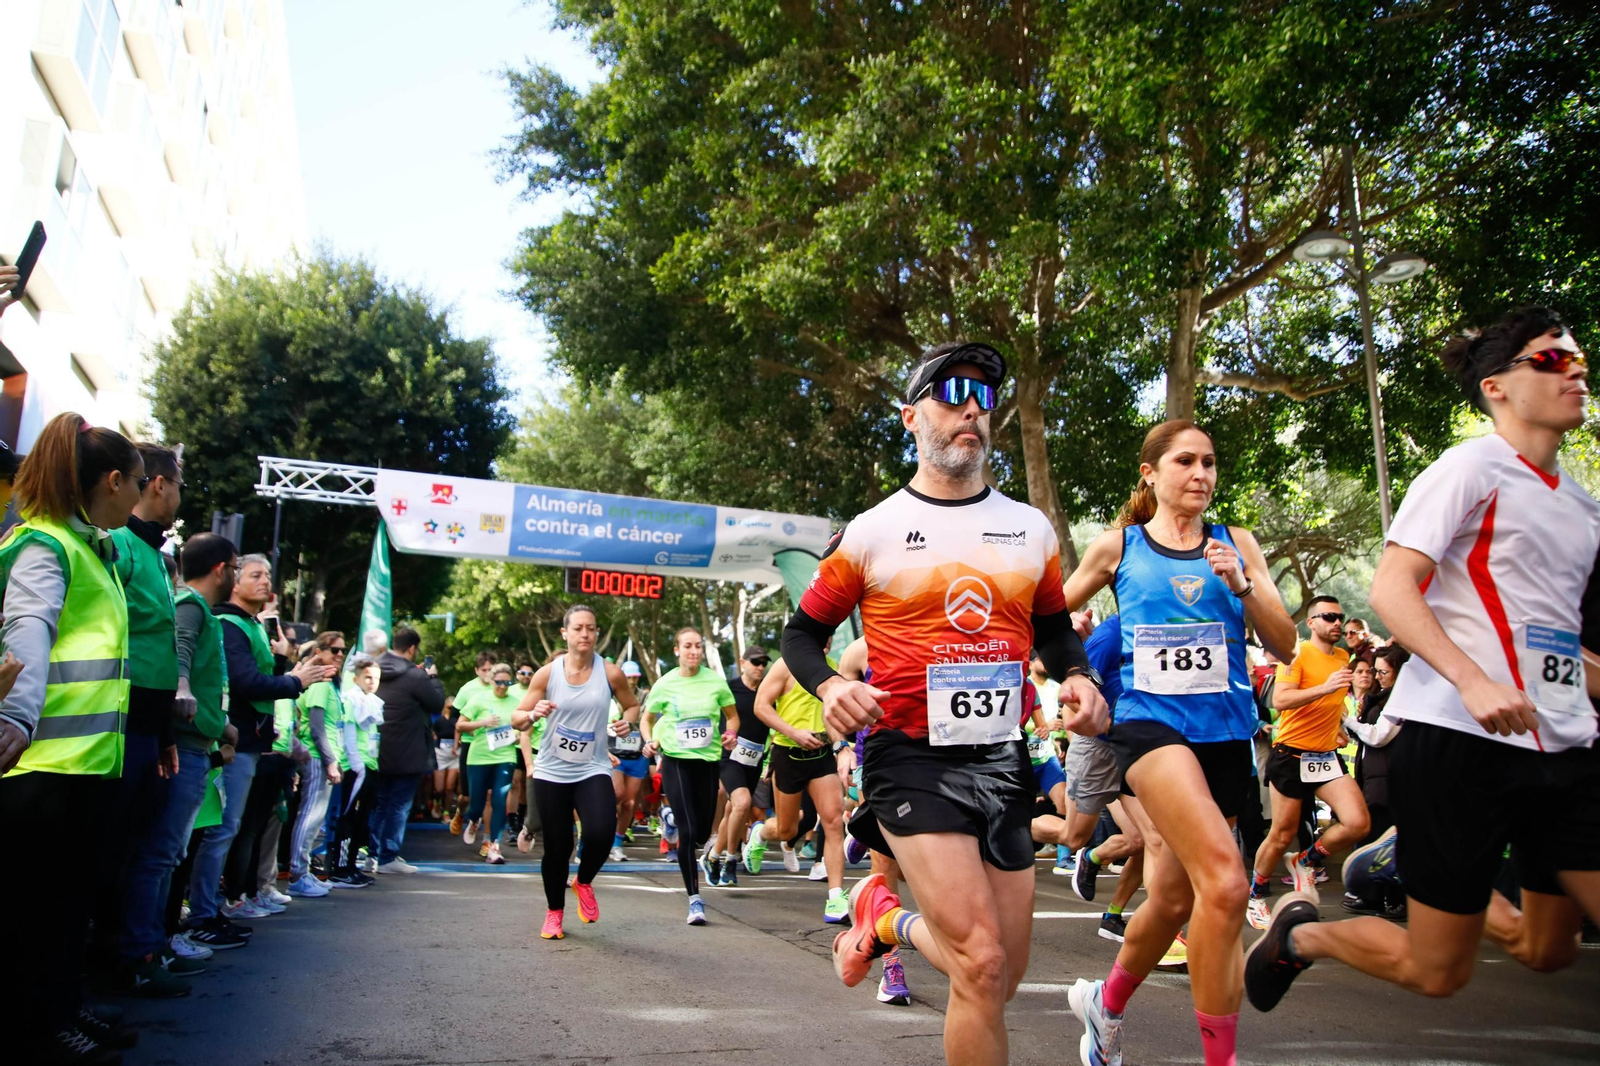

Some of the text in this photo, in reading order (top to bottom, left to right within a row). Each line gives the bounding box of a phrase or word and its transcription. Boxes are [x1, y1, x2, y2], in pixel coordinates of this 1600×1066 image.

[526, 493, 705, 527] Almería en marcha
[525, 518, 589, 538] contra
[593, 522, 613, 539] el
[617, 525, 683, 545] cáncer
[982, 537, 1028, 547] SALINAS CAR
[988, 654, 1009, 663] CAR
[1154, 647, 1212, 671] 183
[950, 689, 1010, 719] 637
[683, 727, 707, 739] 158
[559, 737, 588, 753] 267
[1028, 743, 1045, 751] 548
[739, 747, 758, 759] 340
[1308, 761, 1331, 772] 676
